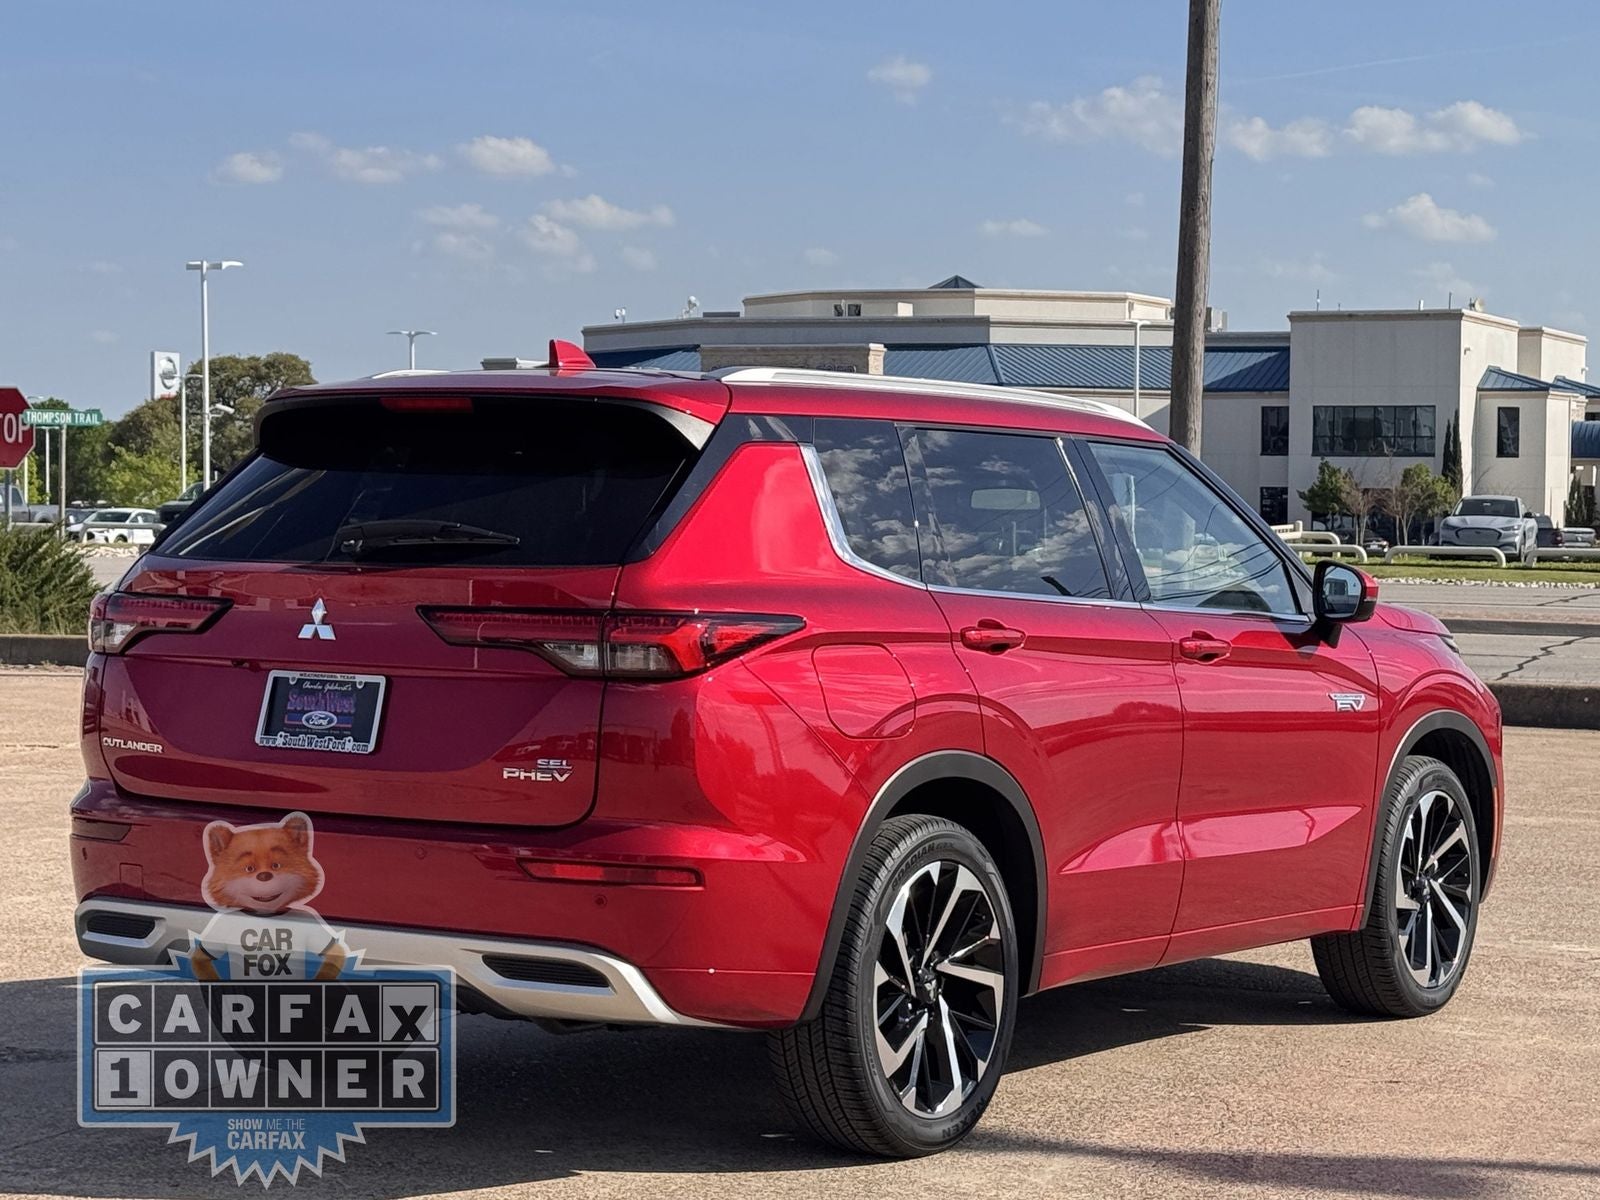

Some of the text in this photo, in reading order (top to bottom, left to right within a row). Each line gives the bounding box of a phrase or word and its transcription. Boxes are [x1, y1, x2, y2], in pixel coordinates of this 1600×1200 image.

[26, 411, 100, 425] THOMPSON TRAIL
[0, 413, 31, 443] OP
[309, 713, 330, 726] Ford
[102, 736, 163, 754] OUTLANDER
[537, 758, 572, 769] SEL
[502, 767, 573, 782] PHEV
